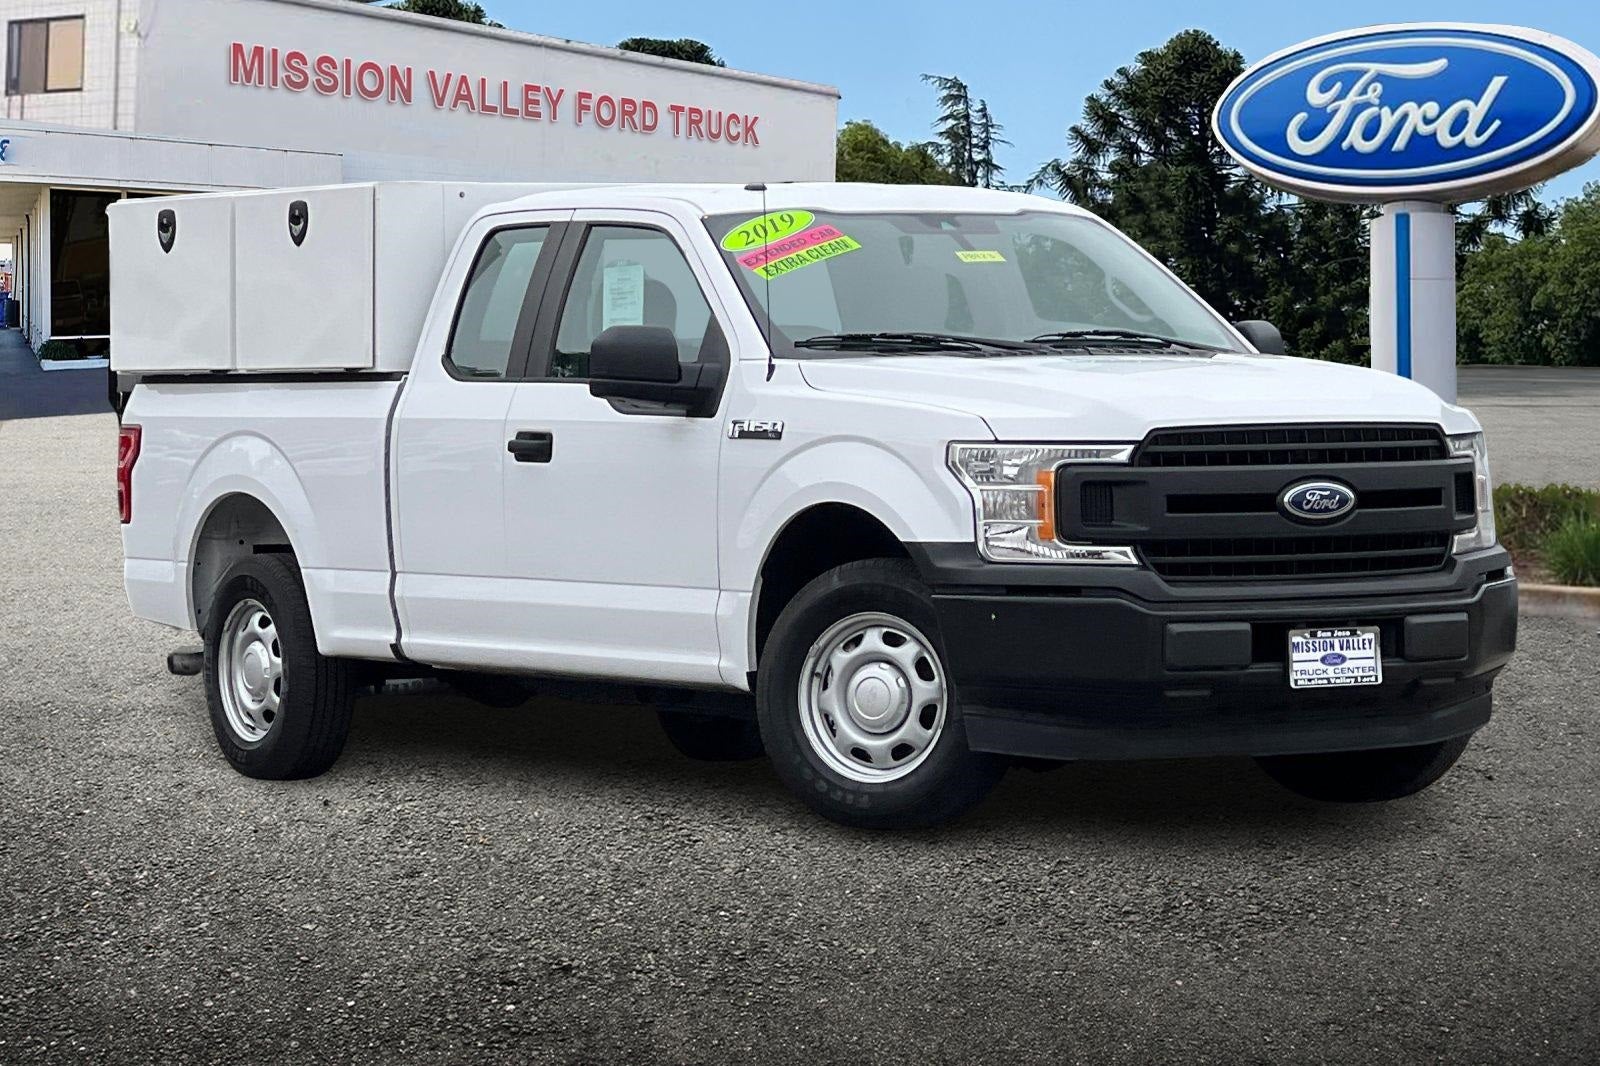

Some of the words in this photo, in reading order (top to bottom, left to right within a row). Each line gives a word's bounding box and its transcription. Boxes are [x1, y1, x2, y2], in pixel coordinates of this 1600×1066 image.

[229, 41, 414, 105] MISSION
[427, 69, 565, 122] VALLEY
[575, 90, 659, 133] FORD
[669, 103, 761, 146] TRUCK
[1286, 57, 1509, 157] Ford
[737, 212, 795, 247] 2019
[743, 237, 807, 267] EXTENDED
[810, 227, 837, 241] CAB
[761, 253, 808, 277] EXTRA
[806, 239, 851, 261] CLEAN
[1302, 489, 1340, 510] Ford
[1292, 640, 1335, 653] MISSION
[1338, 638, 1373, 651] VALLEY
[1333, 666, 1375, 675] CENTER
